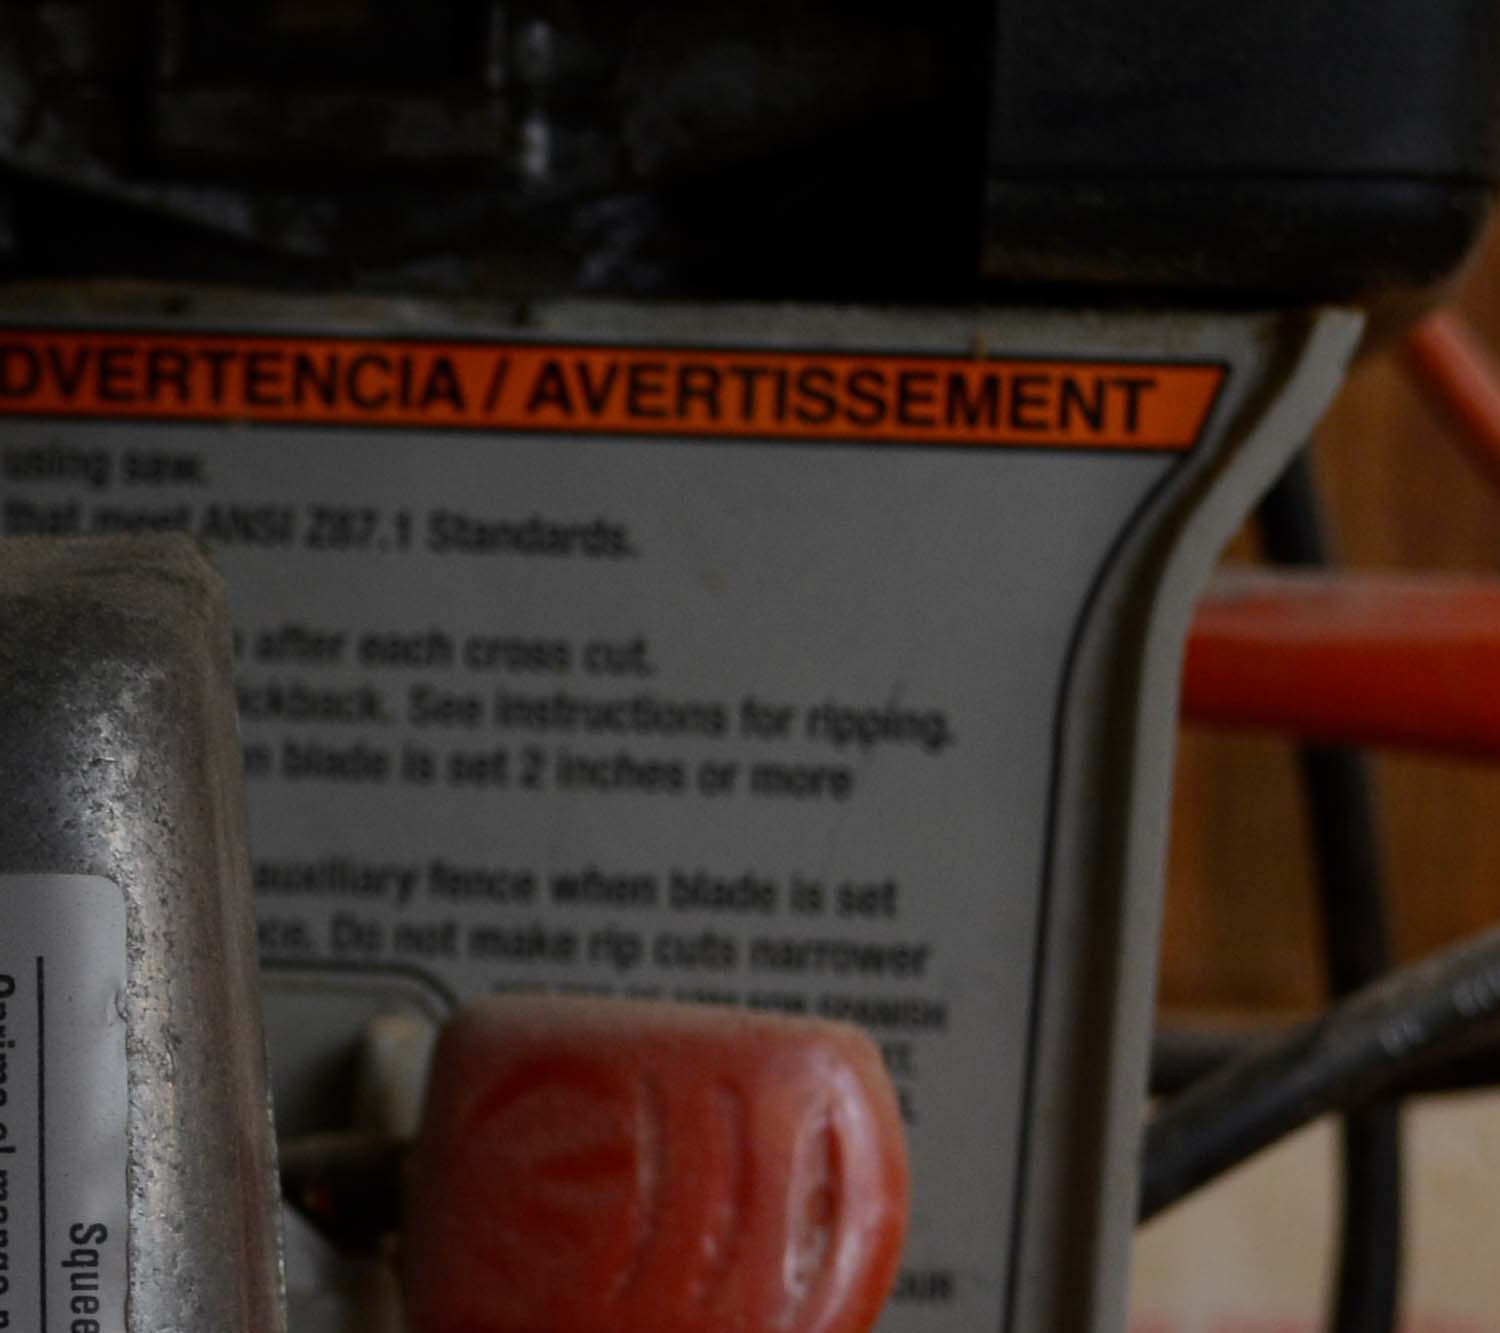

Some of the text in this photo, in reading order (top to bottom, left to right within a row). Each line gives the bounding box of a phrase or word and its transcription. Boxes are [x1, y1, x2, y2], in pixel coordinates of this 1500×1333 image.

[526, 363, 1158, 435] AVERTISSEMENT
[3, 446, 110, 488] using
[3, 500, 80, 536] that
[201, 499, 294, 549] ANSI
[303, 502, 412, 552] Z87.1
[427, 506, 639, 560] Standards.
[255, 622, 347, 666] after
[356, 626, 456, 671] each
[462, 634, 572, 674] cross
[581, 640, 655, 678] cut.
[408, 682, 484, 728] See
[494, 684, 729, 740] instructions
[740, 693, 797, 740] for
[804, 696, 957, 758] ripping.
[281, 738, 391, 785] blade
[401, 740, 436, 788] is
[446, 743, 508, 789] set
[519, 744, 546, 790] 2
[555, 746, 687, 797] inches
[697, 757, 740, 798] or
[750, 760, 857, 804] more
[251, 856, 418, 910] auxiliary
[429, 857, 538, 906] fence
[551, 864, 659, 911] when
[668, 866, 780, 915] blade
[789, 870, 826, 918] is
[834, 875, 898, 922] set
[329, 910, 385, 952] Do
[394, 917, 459, 955] not
[467, 918, 578, 961] make
[587, 922, 644, 975] rip
[652, 926, 740, 973] cuts
[748, 935, 933, 982] narrower
